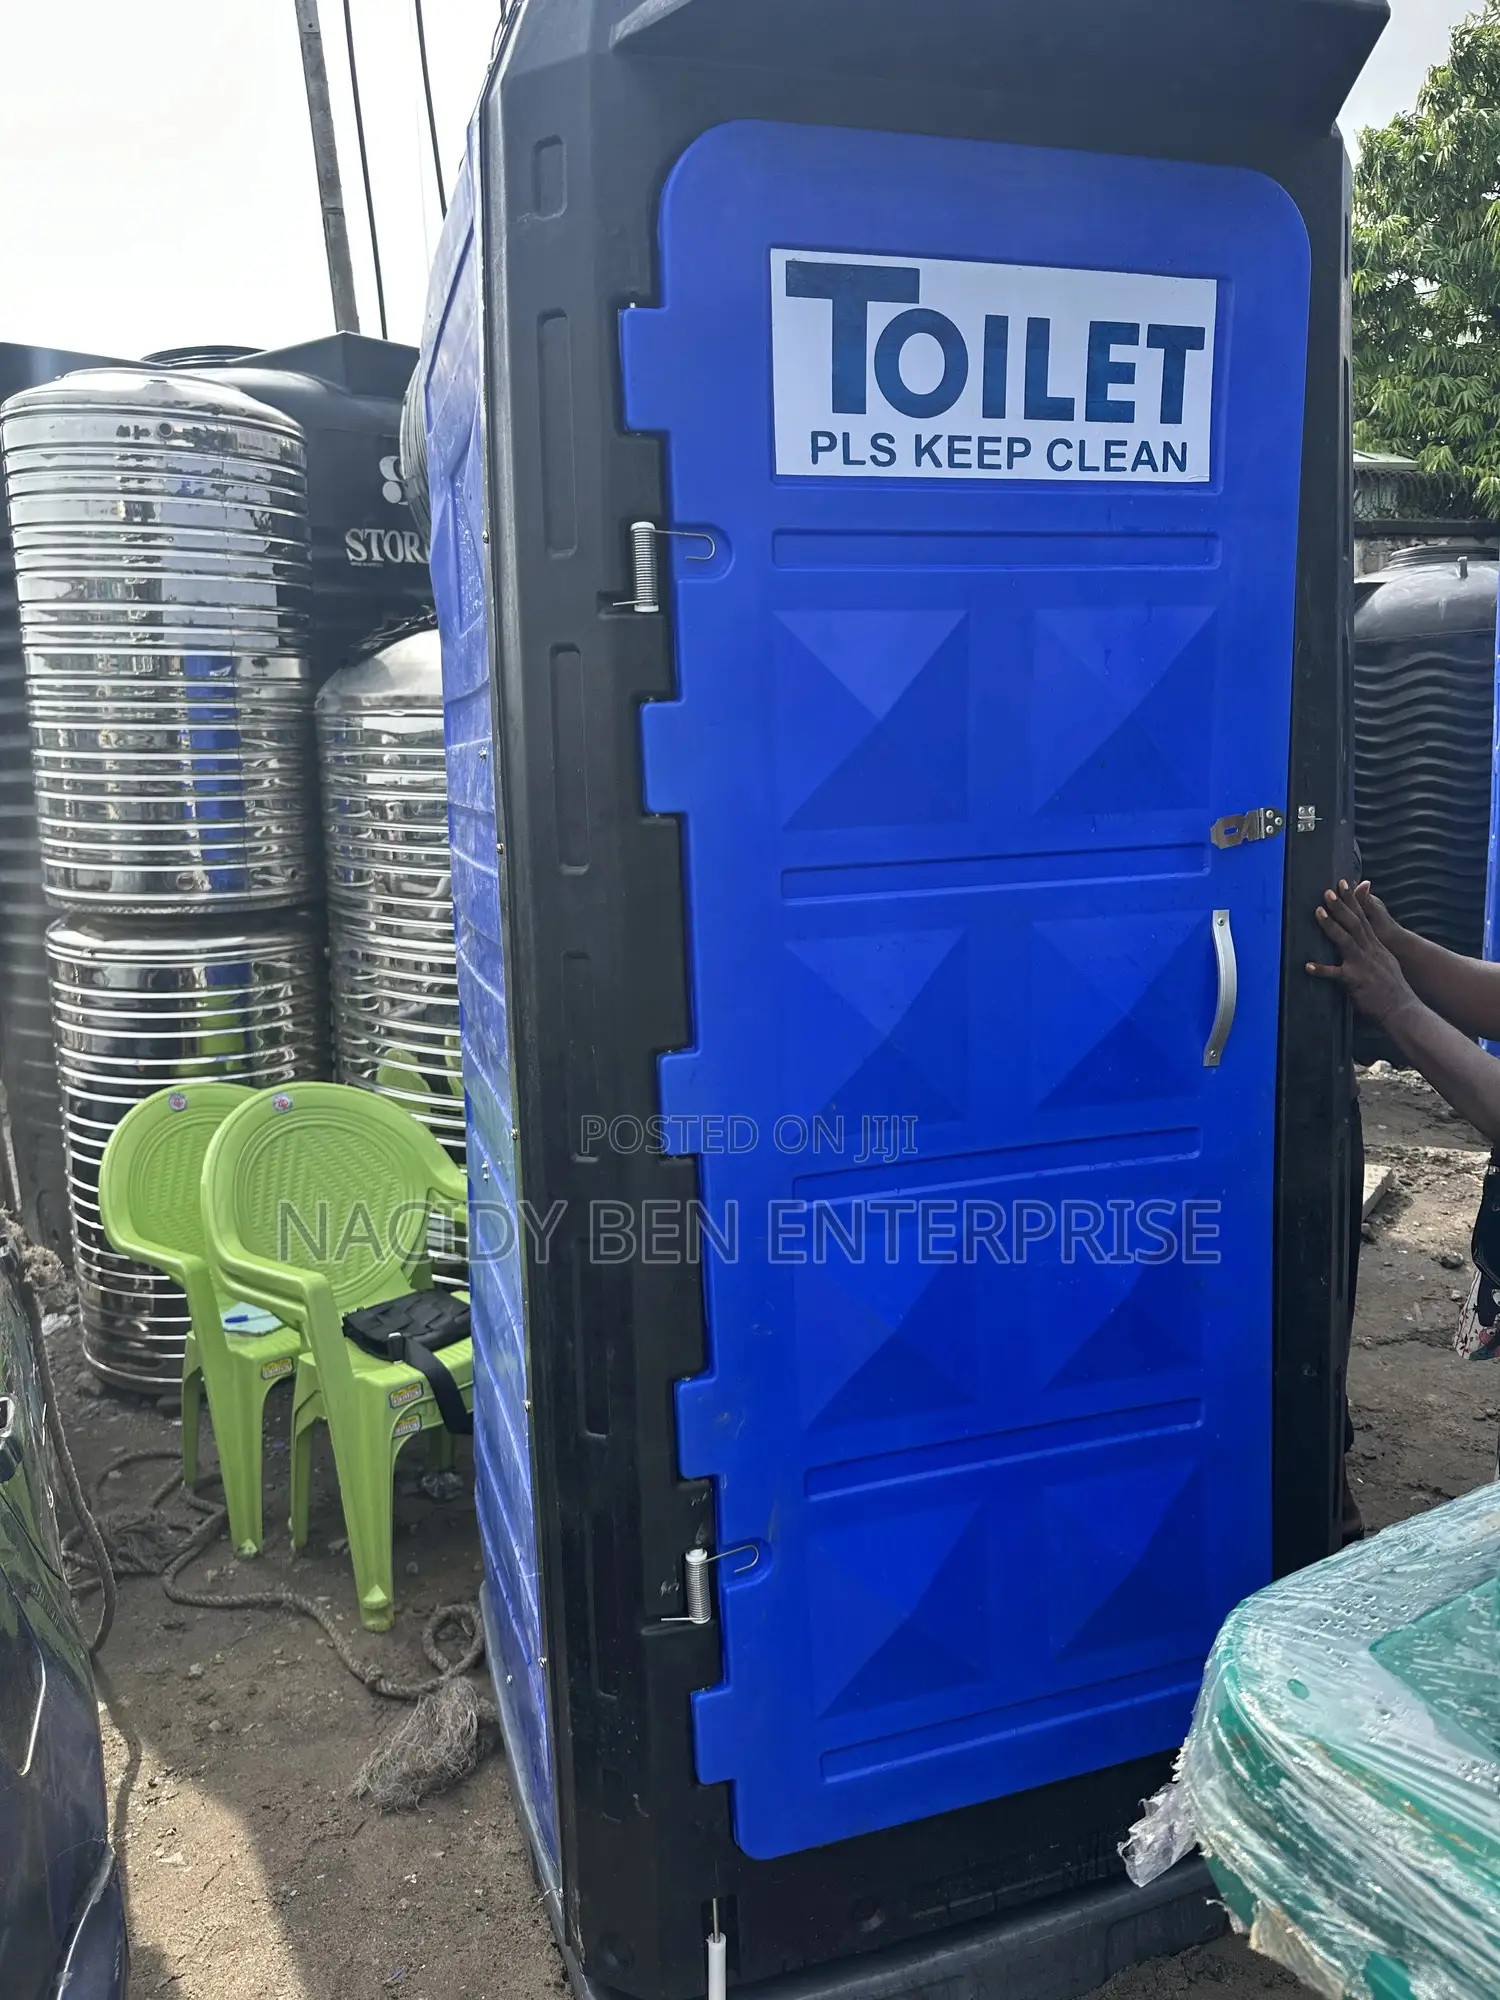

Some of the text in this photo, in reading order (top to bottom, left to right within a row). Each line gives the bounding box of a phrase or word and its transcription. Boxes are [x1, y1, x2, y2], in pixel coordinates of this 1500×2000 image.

[785, 260, 1206, 425] TOILET
[810, 430, 1188, 474] PLS KEEP CLEAN
[345, 527, 430, 564] STOR
